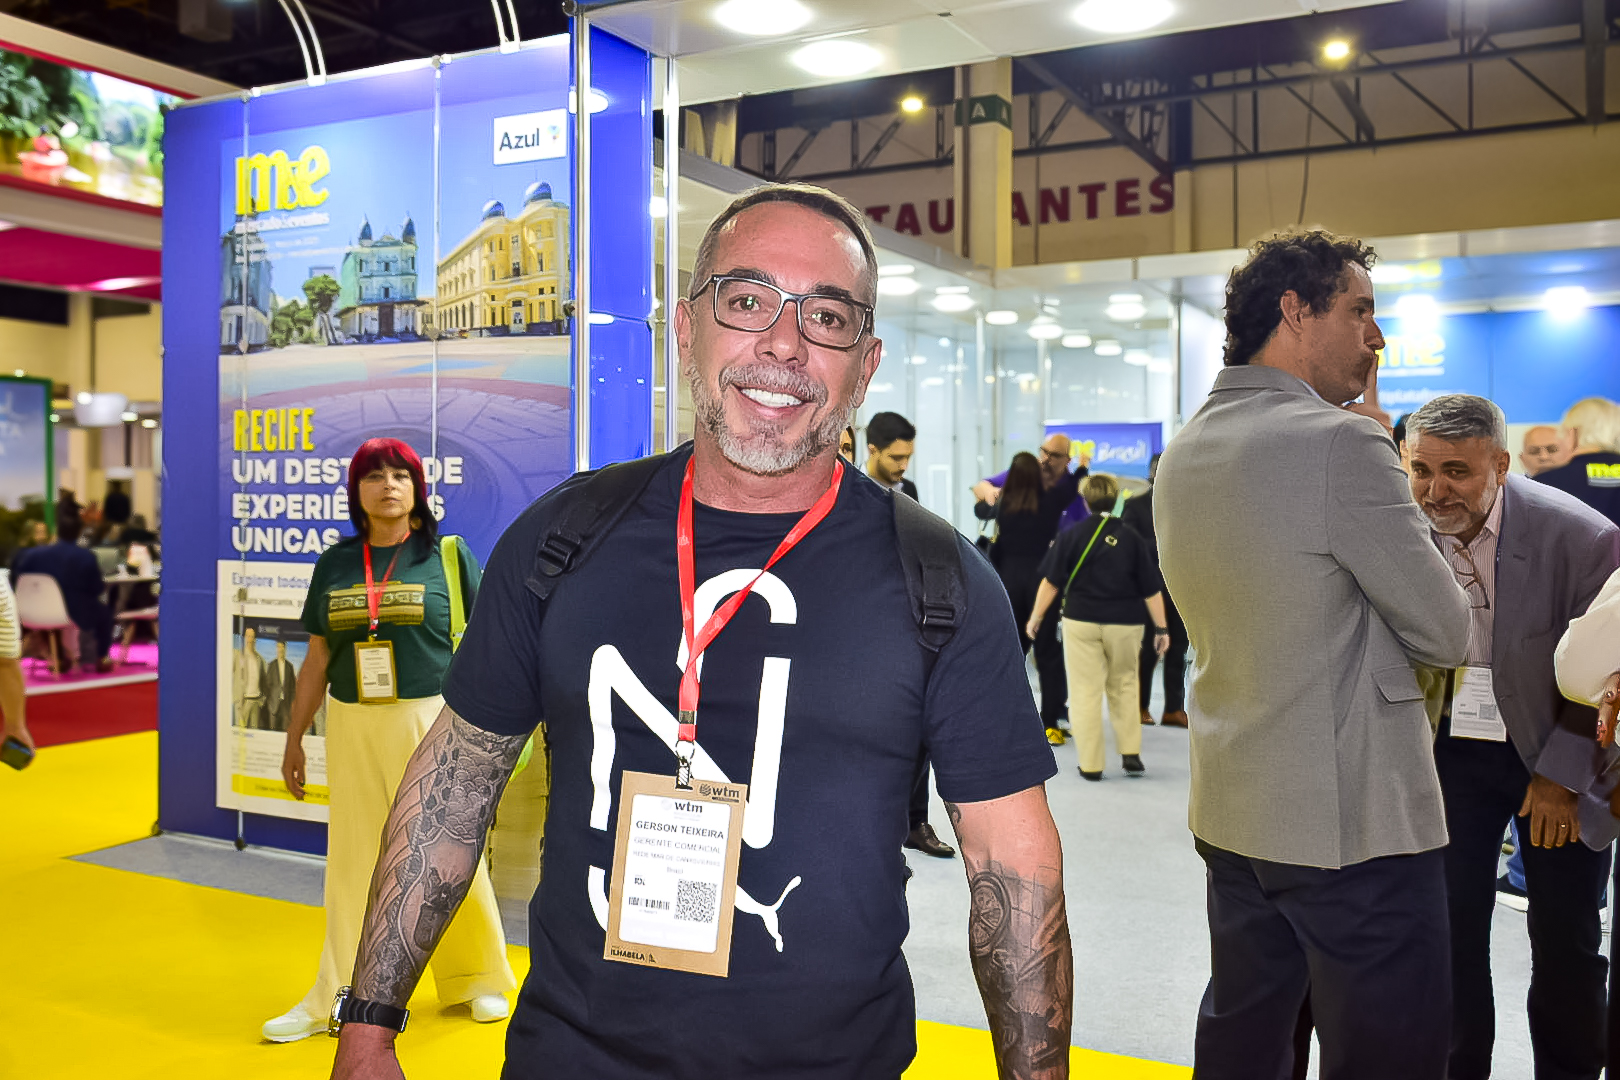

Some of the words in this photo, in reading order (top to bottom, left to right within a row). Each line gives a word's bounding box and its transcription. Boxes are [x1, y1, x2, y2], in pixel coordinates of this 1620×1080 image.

[971, 102, 986, 119] A
[499, 127, 540, 152] Azul
[233, 408, 315, 451] RECIFE
[232, 458, 277, 484] UM
[423, 456, 463, 484] DE
[231, 519, 340, 554] ÚNICAS
[712, 786, 740, 798] wtm
[674, 801, 703, 813] wtm
[635, 820, 677, 833] GERSON
[680, 825, 724, 839] TEIXEIRA
[633, 836, 672, 848] GERENTE
[674, 842, 720, 854] COMERCIAL
[610, 947, 645, 961] ILHABELA
